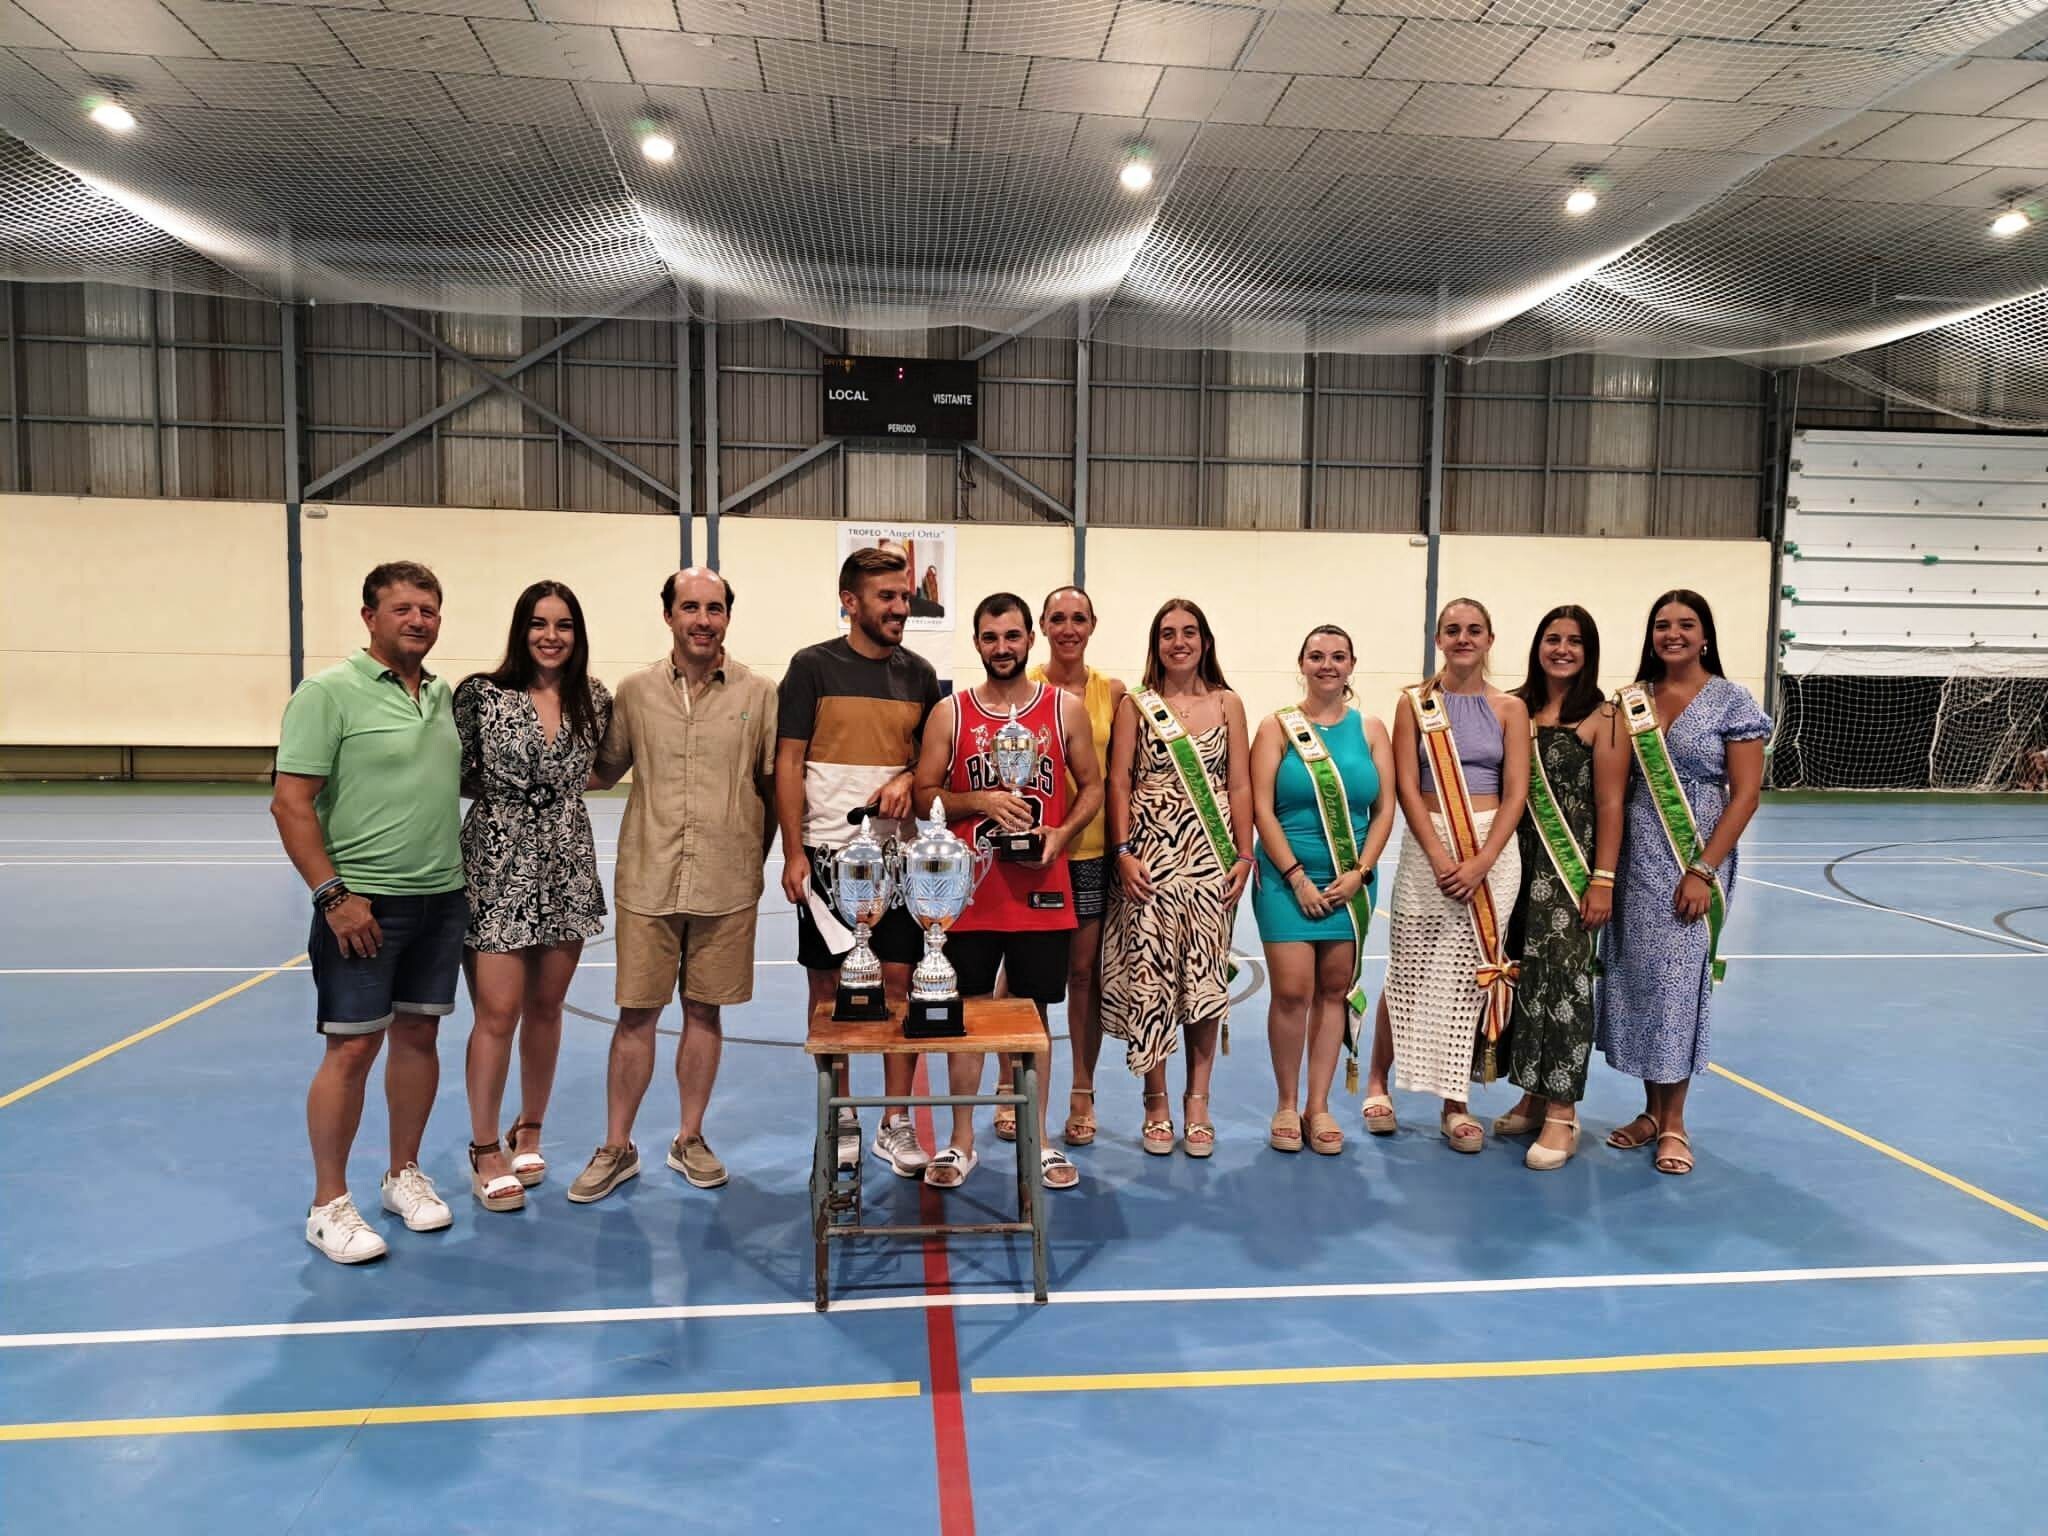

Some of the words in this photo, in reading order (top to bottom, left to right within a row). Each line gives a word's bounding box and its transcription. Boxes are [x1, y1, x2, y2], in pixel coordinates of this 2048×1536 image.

[828, 389, 869, 401] LOCAL
[932, 393, 973, 406] VISITANTE
[887, 423, 916, 433] PERIODO
[848, 528, 881, 537] TROFEO
[965, 752, 1053, 797] BUS
